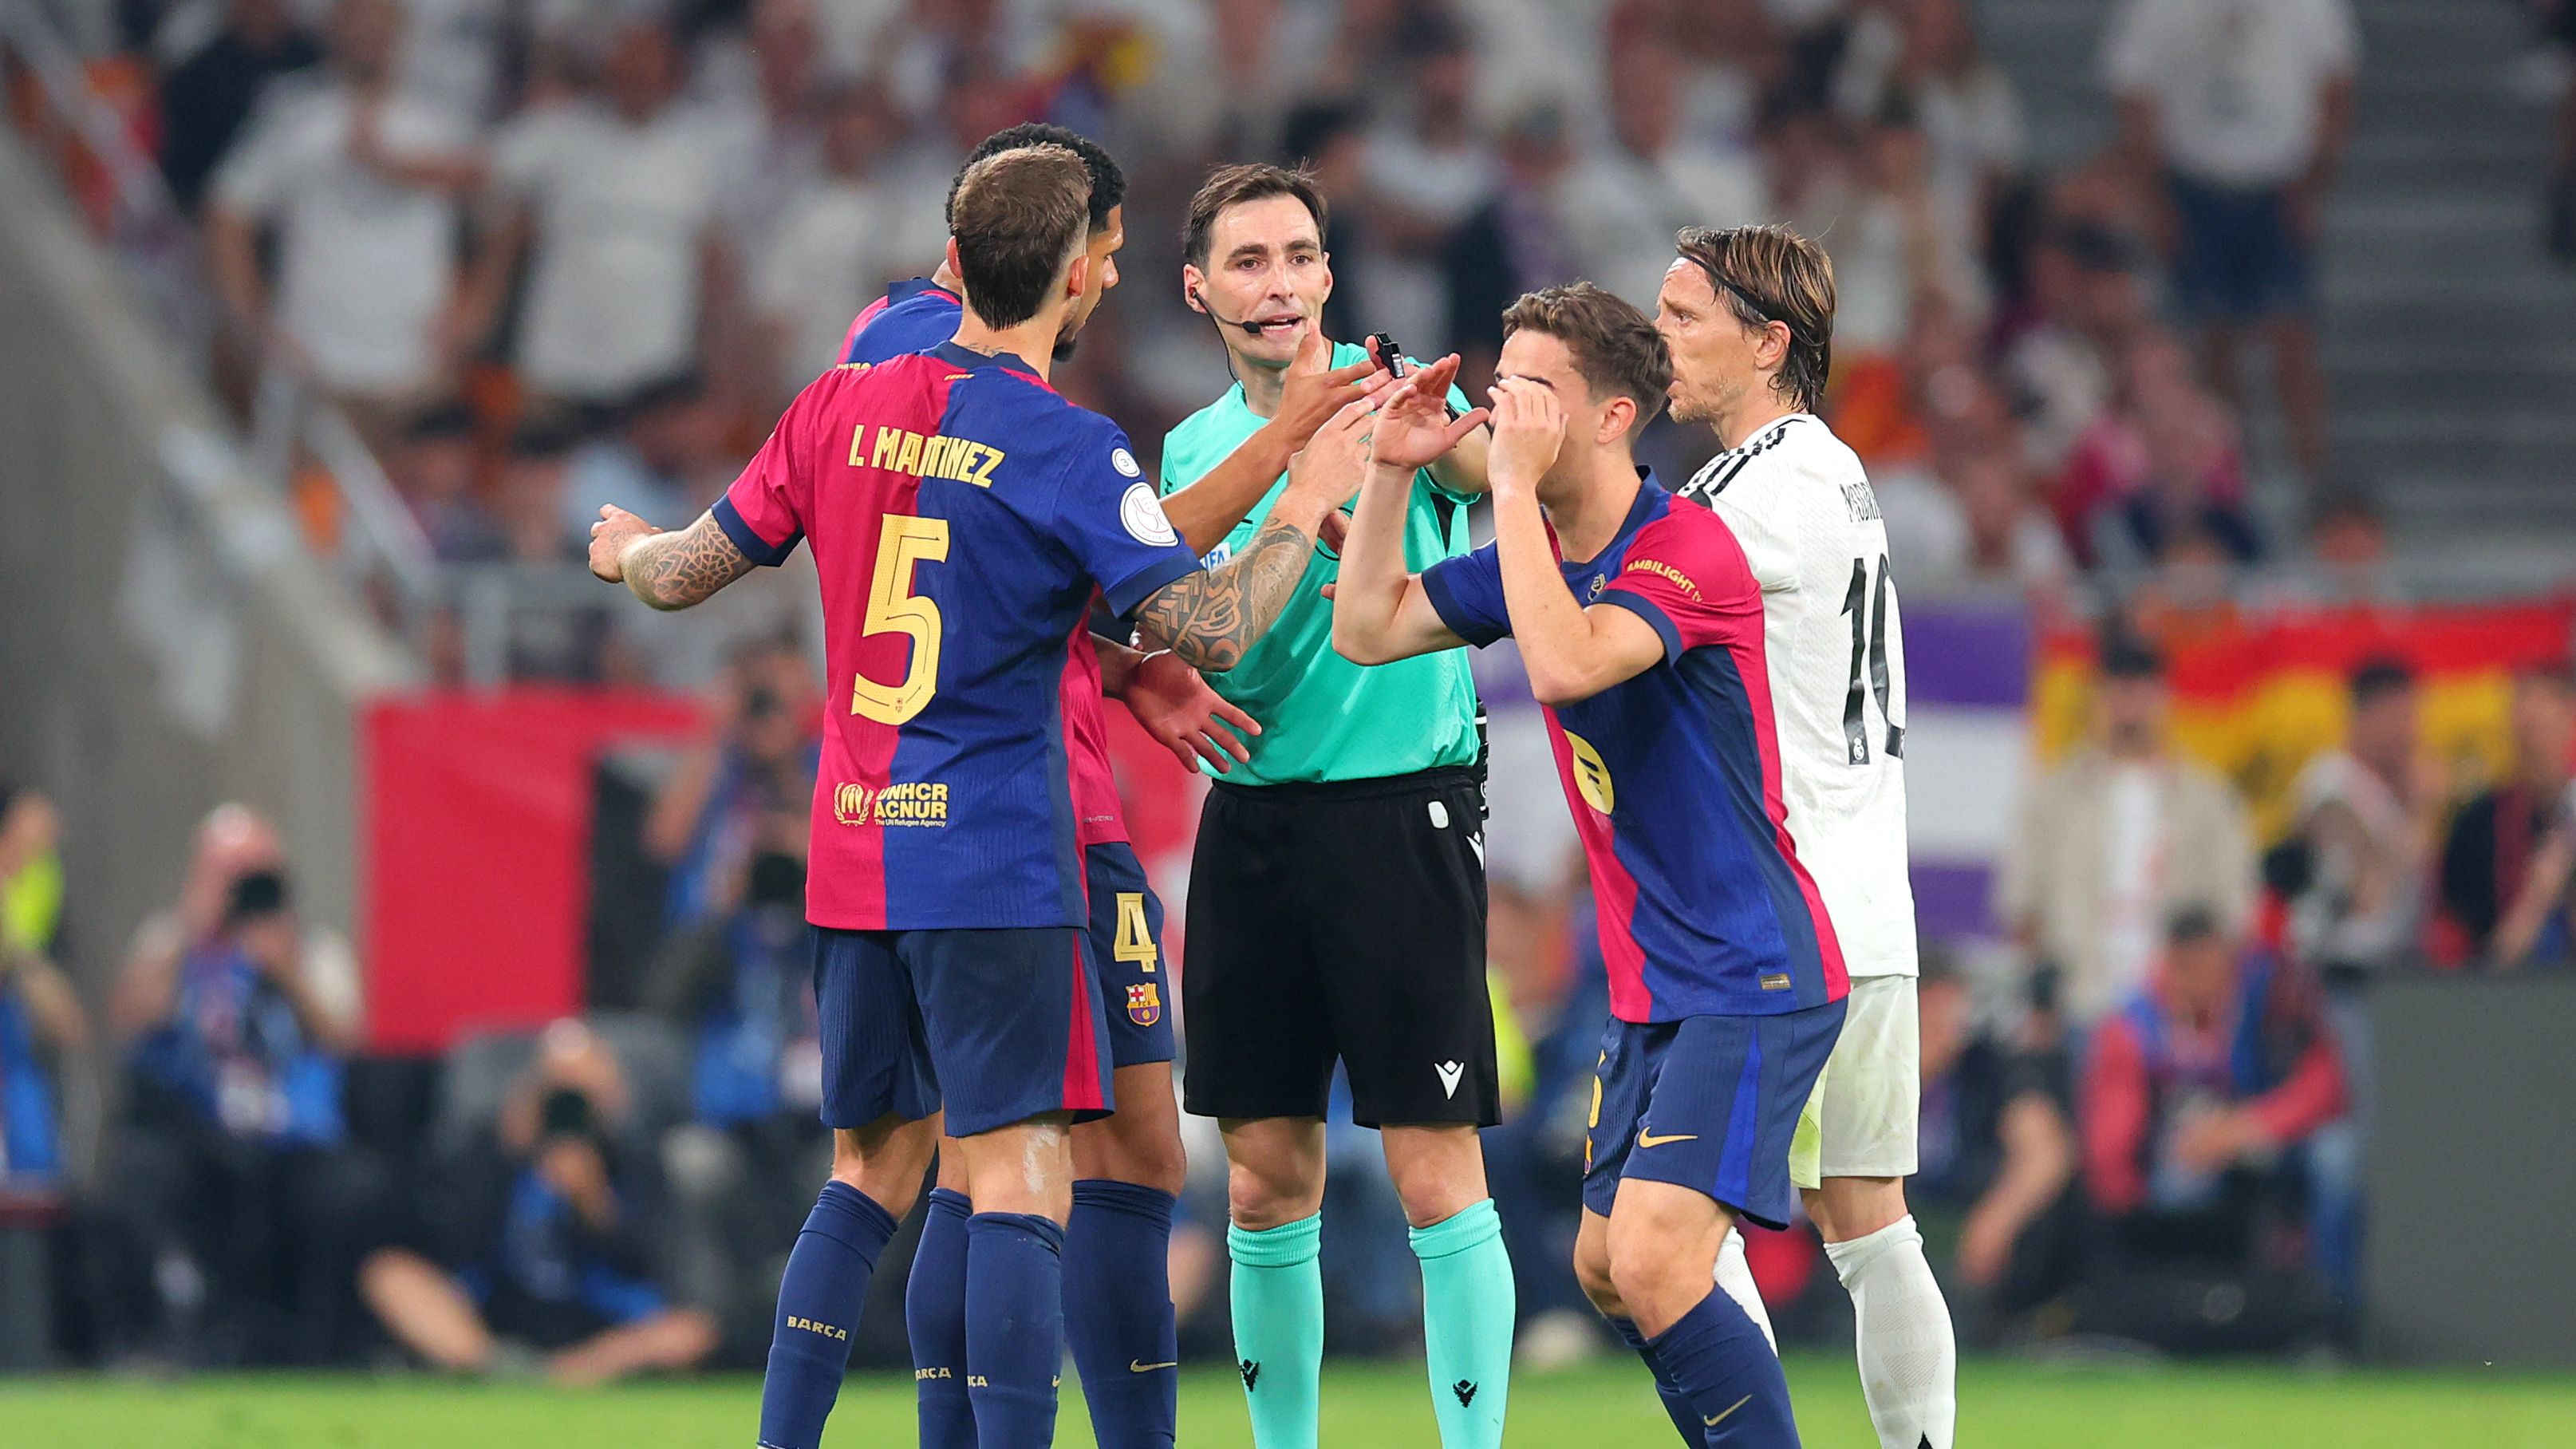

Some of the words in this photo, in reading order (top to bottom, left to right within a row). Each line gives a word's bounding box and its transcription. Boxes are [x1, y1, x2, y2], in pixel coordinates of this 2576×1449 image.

[848, 424, 866, 467] I.
[1203, 550, 1225, 570] IFA
[1627, 559, 1696, 594] AMBILIGHT
[850, 512, 950, 726] 5
[1839, 553, 1907, 766] 10
[875, 782, 949, 801] UNHCR
[874, 800, 947, 819] ACNUR
[894, 819, 920, 827] Refugee
[920, 819, 947, 827] Agency
[1114, 892, 1157, 973] 4
[787, 1315, 847, 1341] BARÇA
[915, 1367, 952, 1381] ARÇA
